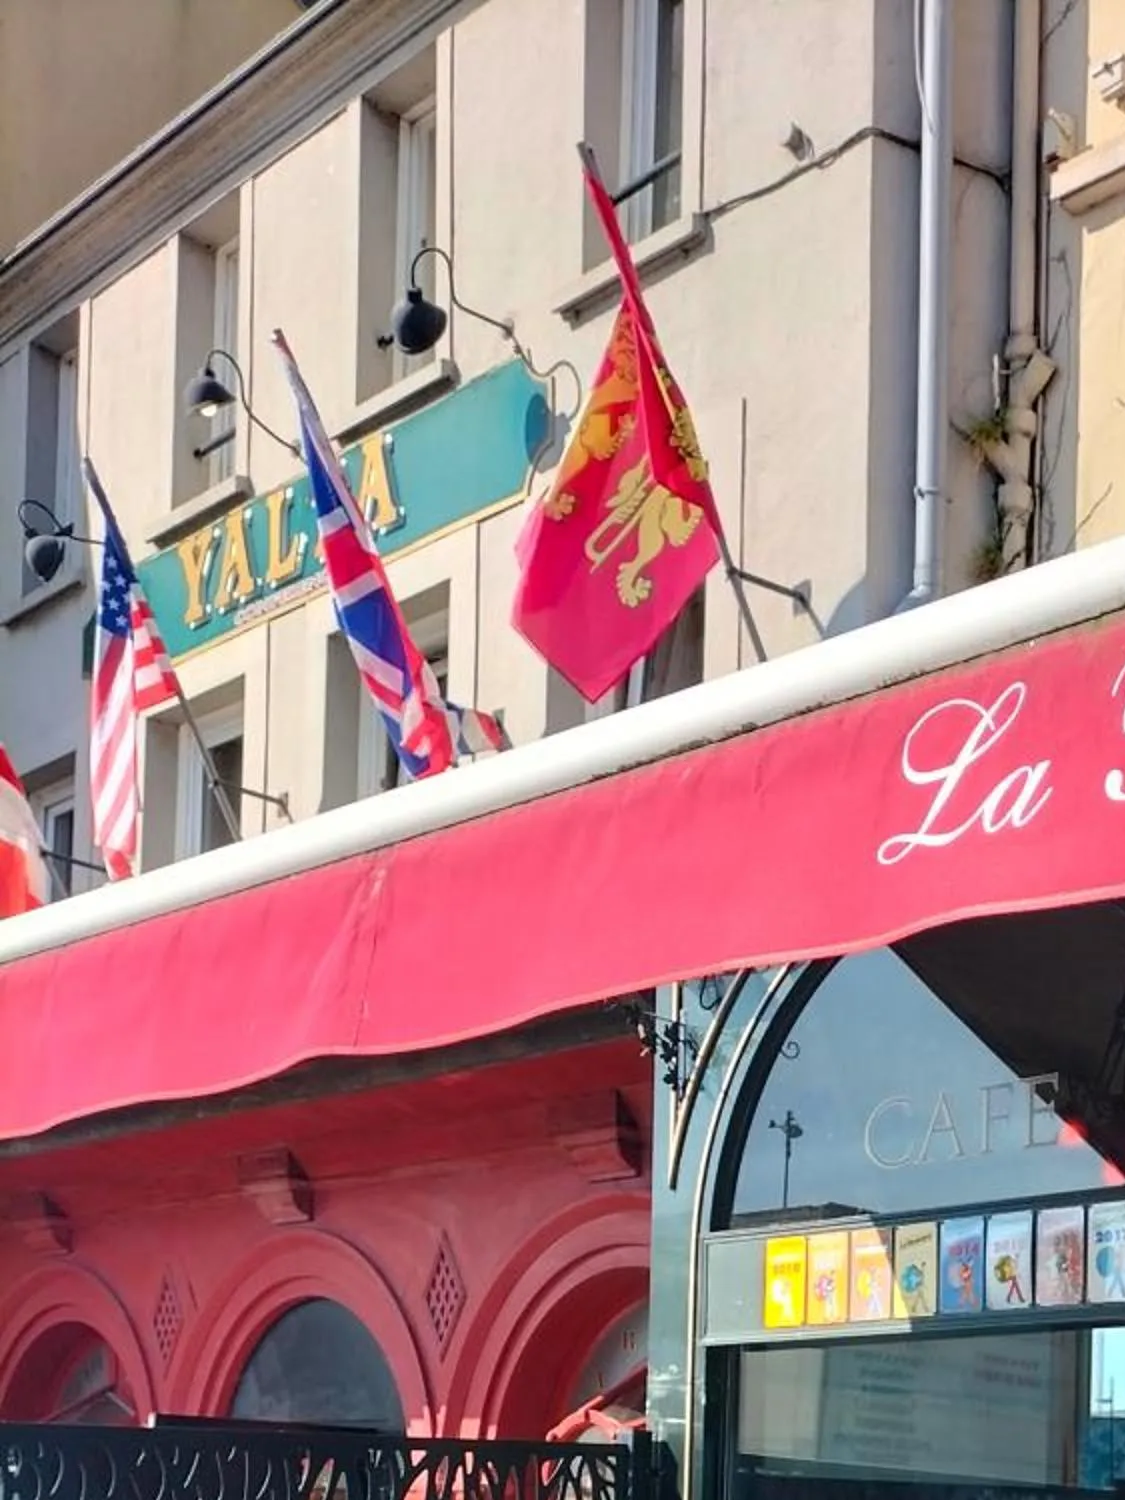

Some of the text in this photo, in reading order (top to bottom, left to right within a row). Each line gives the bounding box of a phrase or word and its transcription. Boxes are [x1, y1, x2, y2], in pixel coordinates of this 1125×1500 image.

[175, 432, 405, 629] YALA
[876, 681, 1053, 865] La
[863, 1071, 1060, 1169] CAFE
